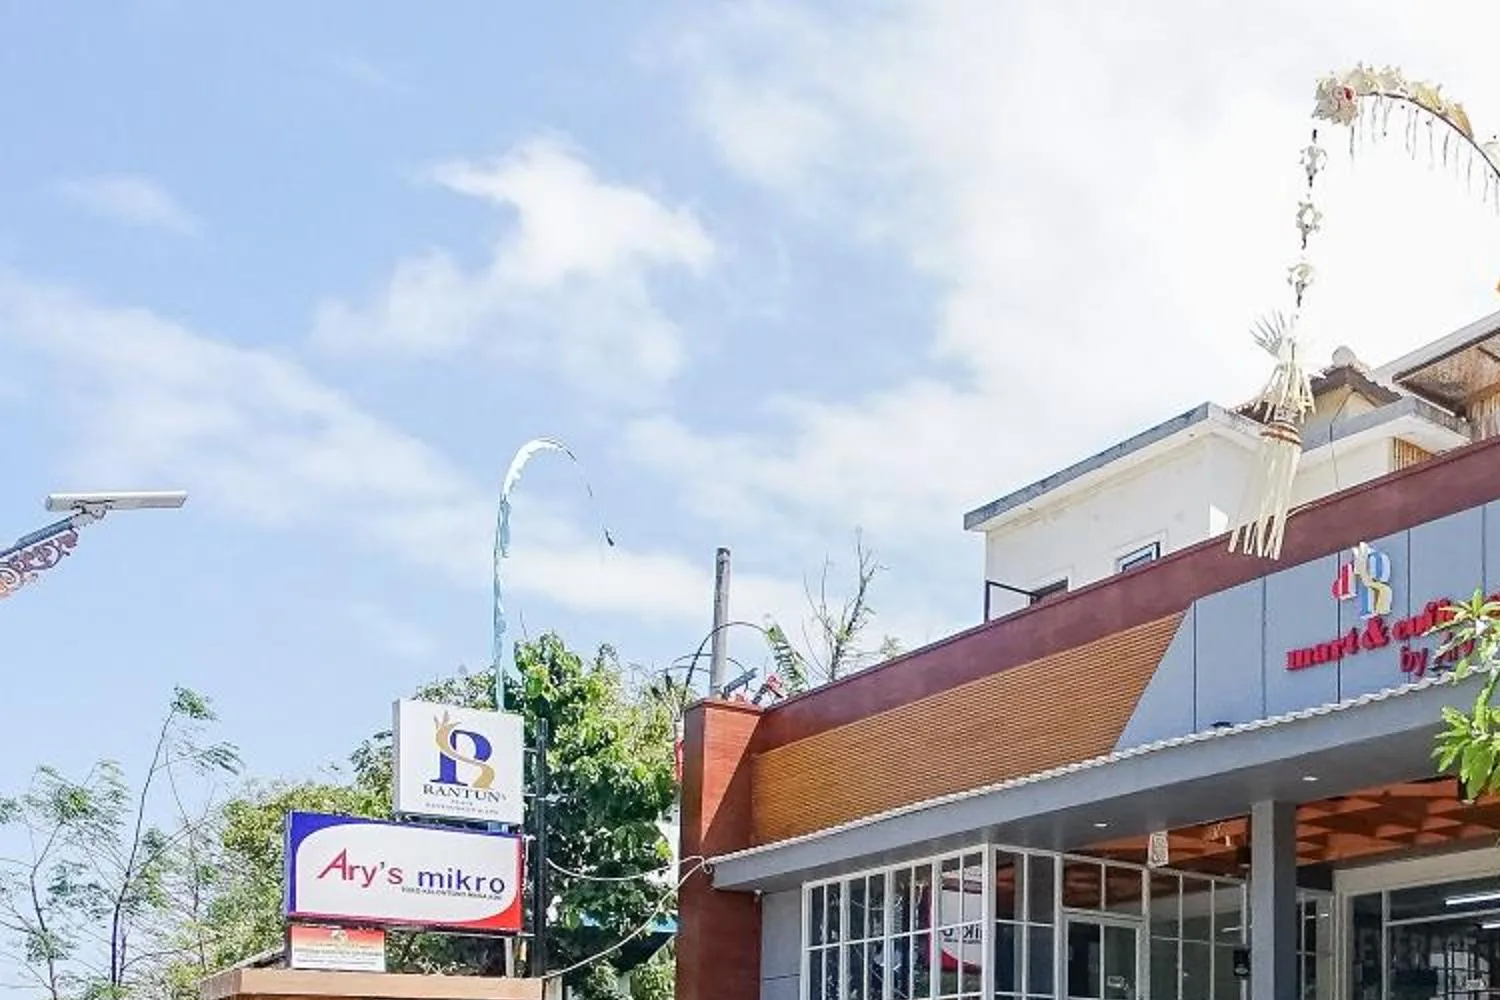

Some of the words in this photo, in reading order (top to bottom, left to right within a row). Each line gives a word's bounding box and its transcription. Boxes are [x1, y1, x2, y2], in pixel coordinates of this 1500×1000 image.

[1286, 627, 1360, 671] mart
[1361, 615, 1391, 650] &
[1401, 646, 1428, 677] by
[317, 848, 404, 888] Ary's
[417, 867, 506, 894] mikro
